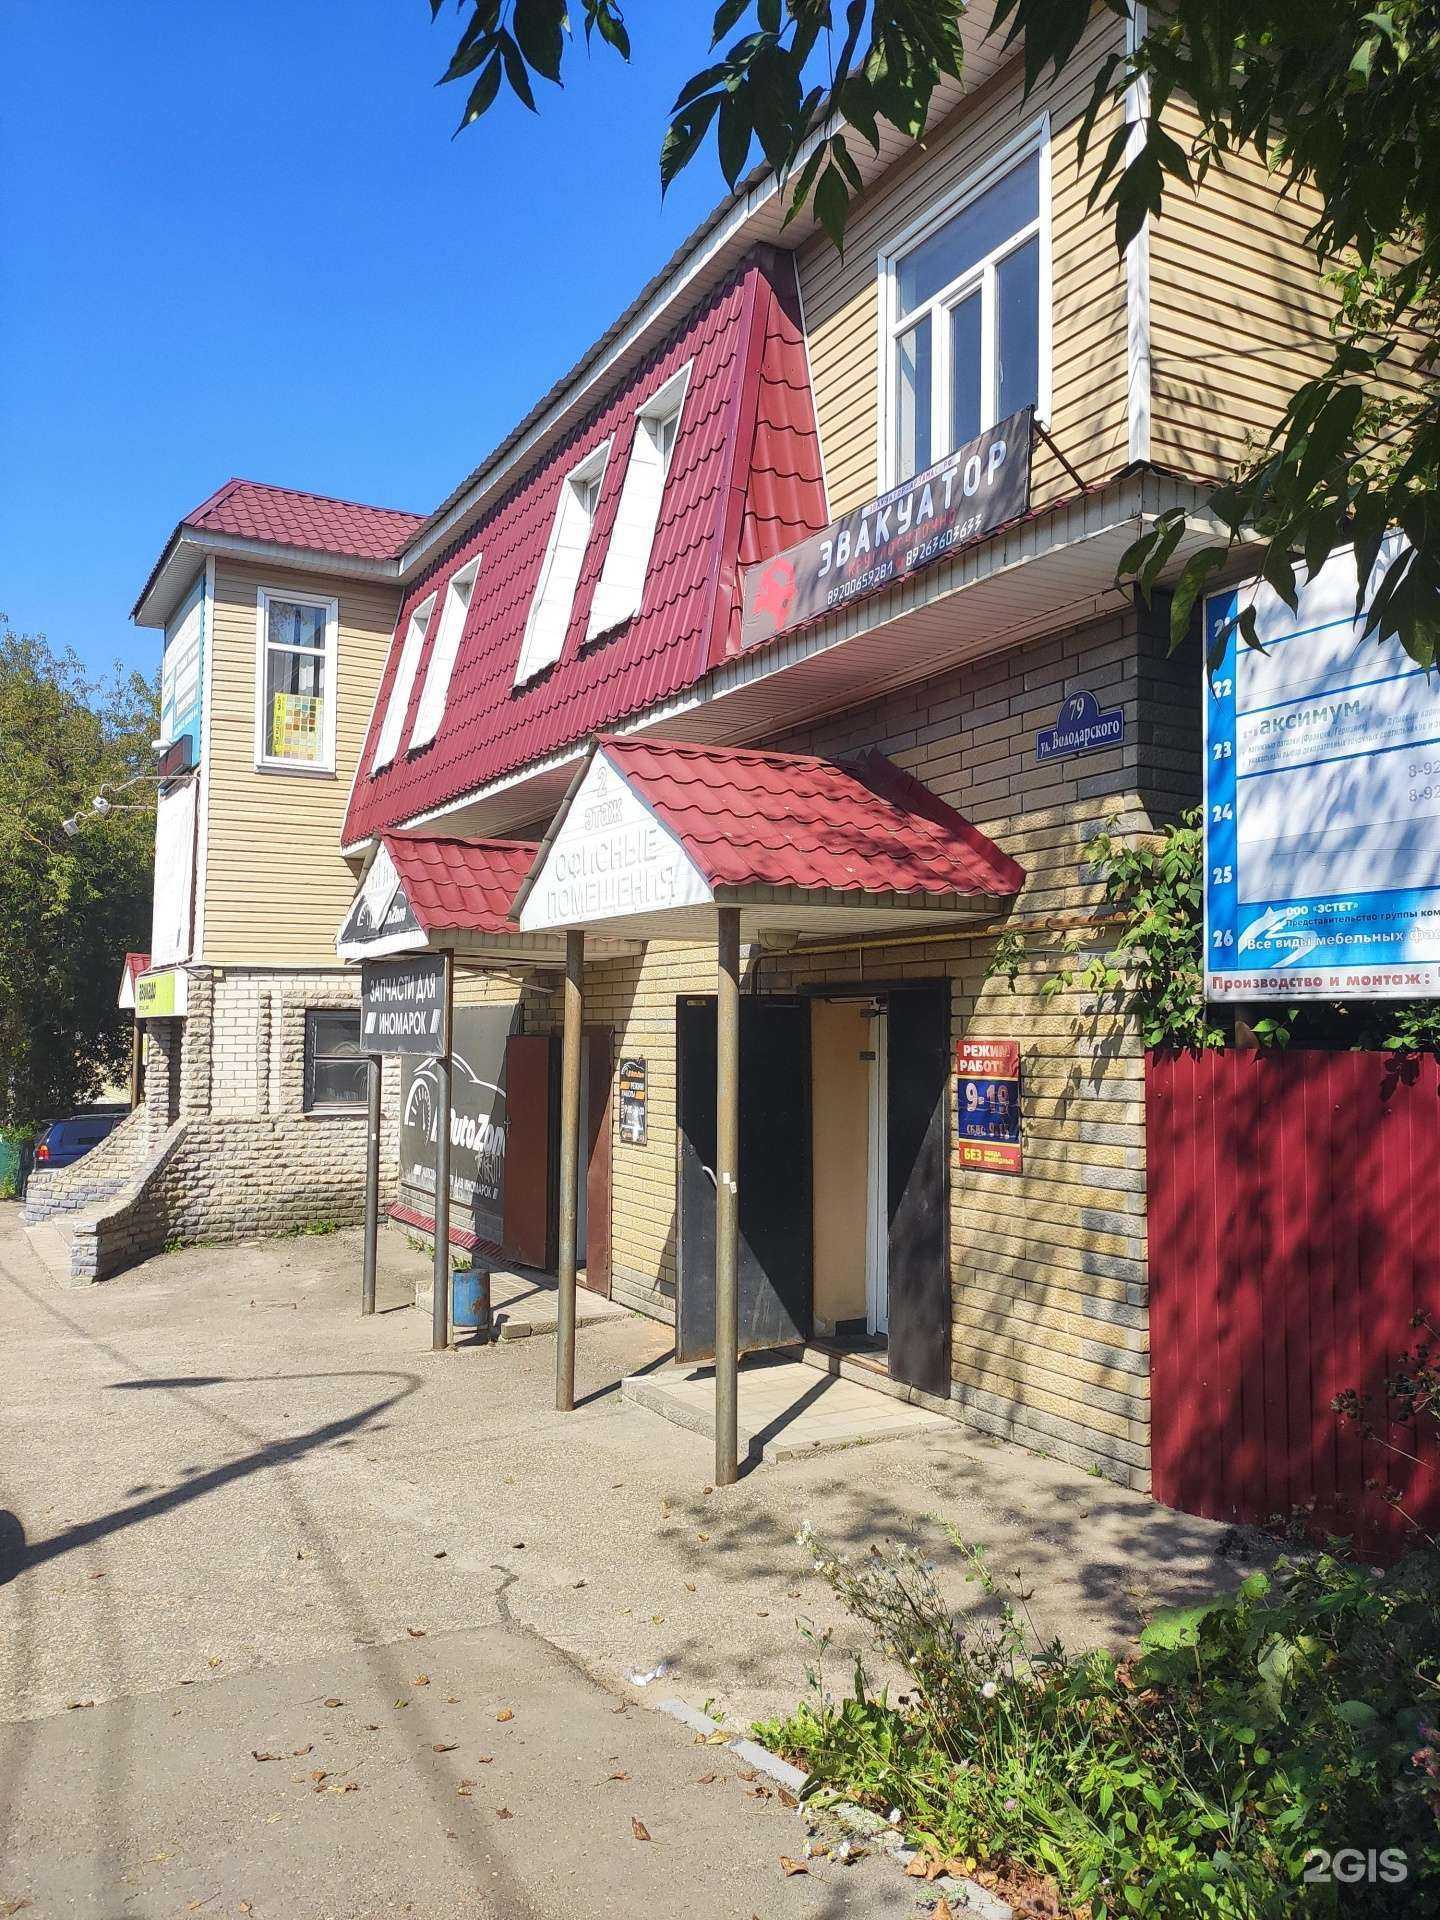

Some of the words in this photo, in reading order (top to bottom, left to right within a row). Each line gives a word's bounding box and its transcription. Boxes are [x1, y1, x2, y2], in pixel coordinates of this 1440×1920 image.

[817, 440, 1007, 577] ЭВАКУАТОР
[827, 560, 893, 605] 89200659281
[1069, 697, 1085, 721] 79
[1040, 741, 1051, 757] ул.
[1052, 720, 1120, 749] Володарского
[1212, 741, 1232, 761] 23
[1212, 803, 1234, 823] 24
[554, 829, 657, 882] ОФИСНЫЕ
[1212, 865, 1233, 885] 25
[547, 866, 675, 920] ПОМЕЩЕНИЯ
[1380, 911, 1418, 922] группы
[1212, 929, 1234, 948] 26
[1247, 938, 1272, 951] Все
[1275, 935, 1313, 950] виды
[1316, 929, 1404, 946] мебельных
[369, 975, 415, 1003] ЗАПЧАСТИ
[415, 972, 436, 1004] ДЛЯ
[1211, 975, 1323, 992] Производство
[1329, 974, 1340, 986] и
[379, 1010, 427, 1035] ИНОМАРОК
[430, 1105, 506, 1158] AutoZon
[964, 1148, 982, 1161] БЕЗ
